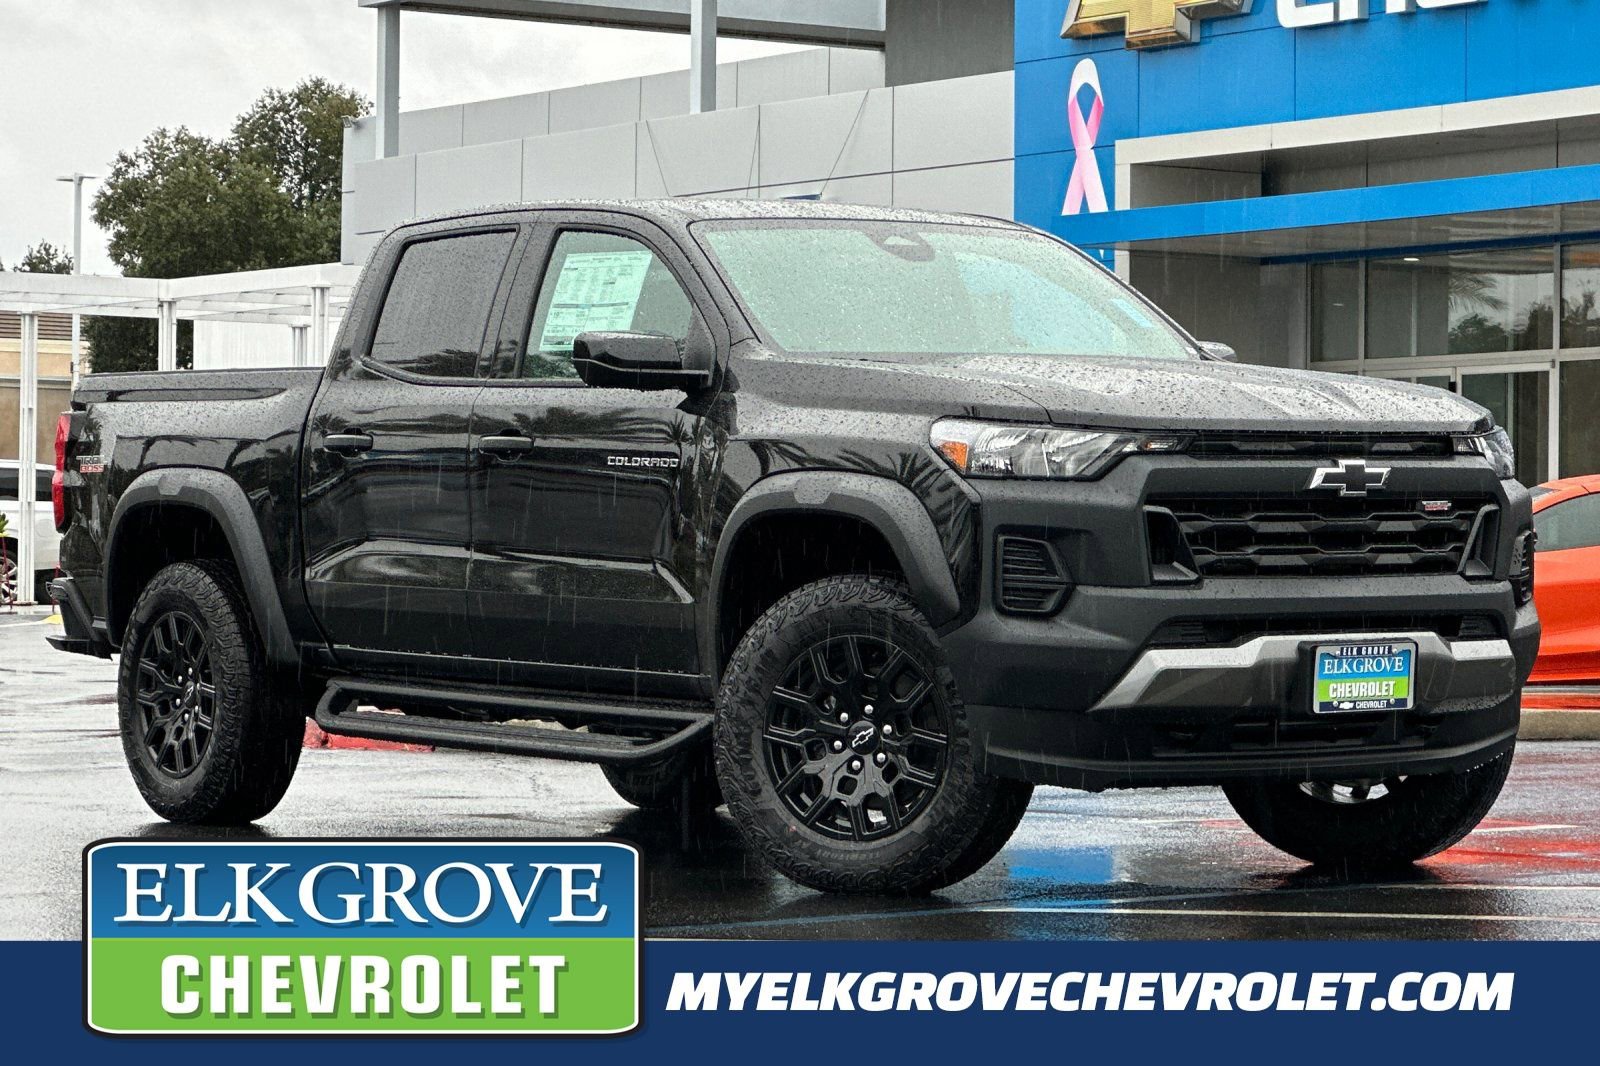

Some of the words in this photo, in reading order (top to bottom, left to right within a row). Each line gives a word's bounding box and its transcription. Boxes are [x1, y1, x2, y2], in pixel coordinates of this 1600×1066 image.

[607, 455, 679, 468] COLORADO
[80, 464, 104, 473] BOSS
[1342, 647, 1360, 656] ELK
[1361, 646, 1389, 655] GROVE
[1323, 658, 1352, 674] ELK
[1353, 656, 1404, 673] GROVE
[1329, 681, 1396, 698] CHEVROLET
[1355, 700, 1388, 709] CHEVROLET
